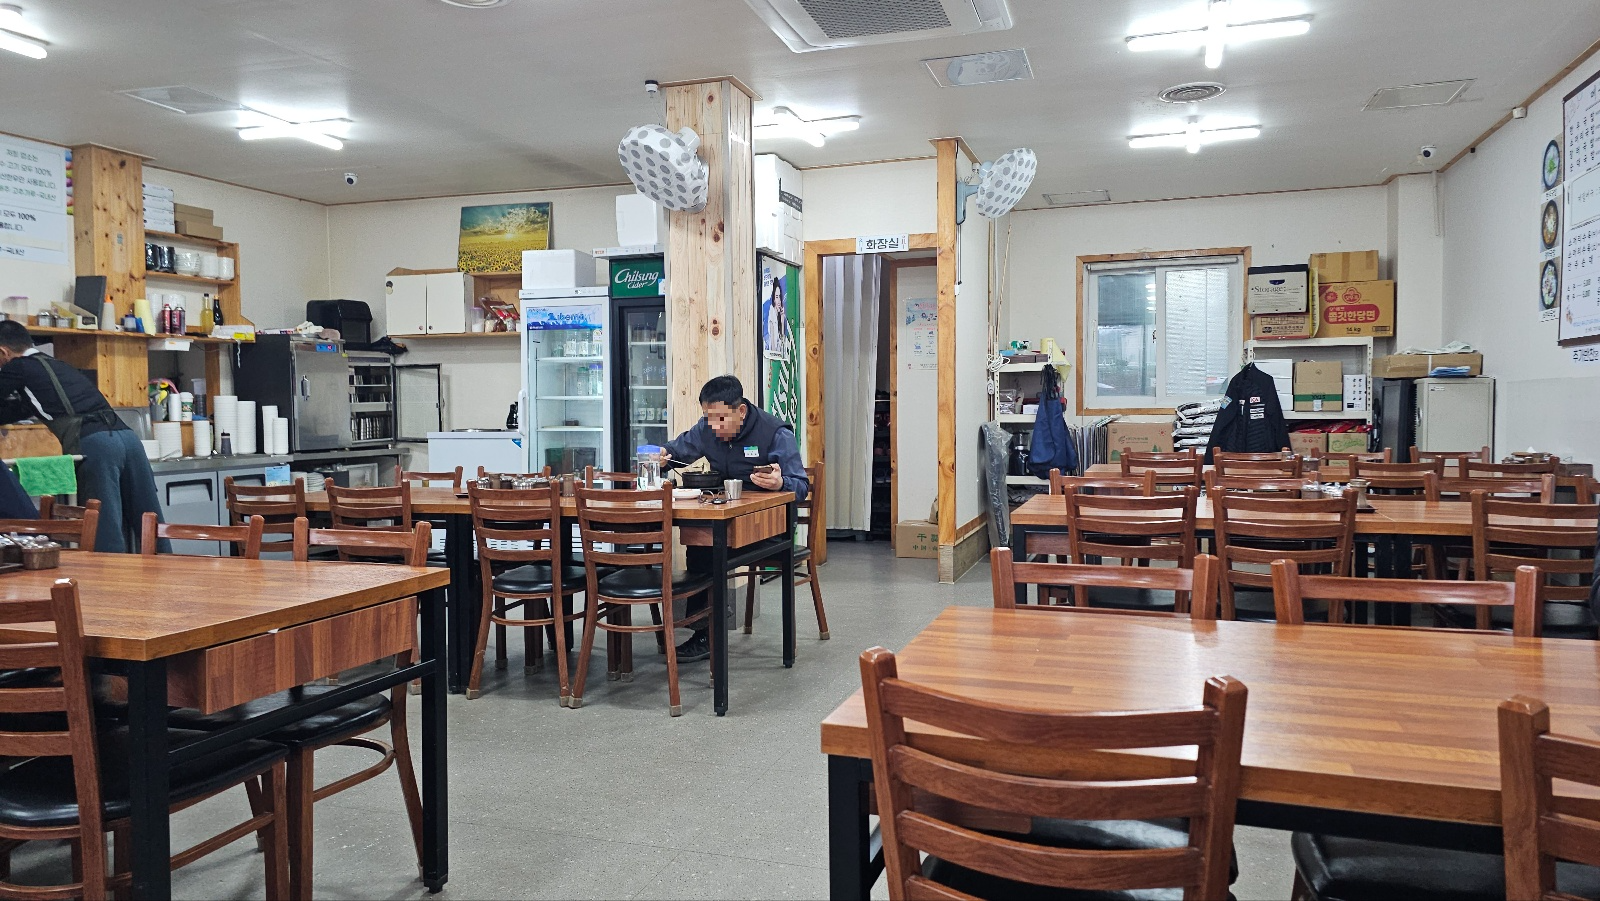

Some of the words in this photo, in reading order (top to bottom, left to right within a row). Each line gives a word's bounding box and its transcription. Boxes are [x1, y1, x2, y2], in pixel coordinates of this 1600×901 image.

[34, 166, 52, 177] 100%
[17, 212, 36, 221] 100%
[866, 237, 899, 250] 화장실
[614, 268, 659, 286] Chilsung
[627, 281, 649, 289] Cider
